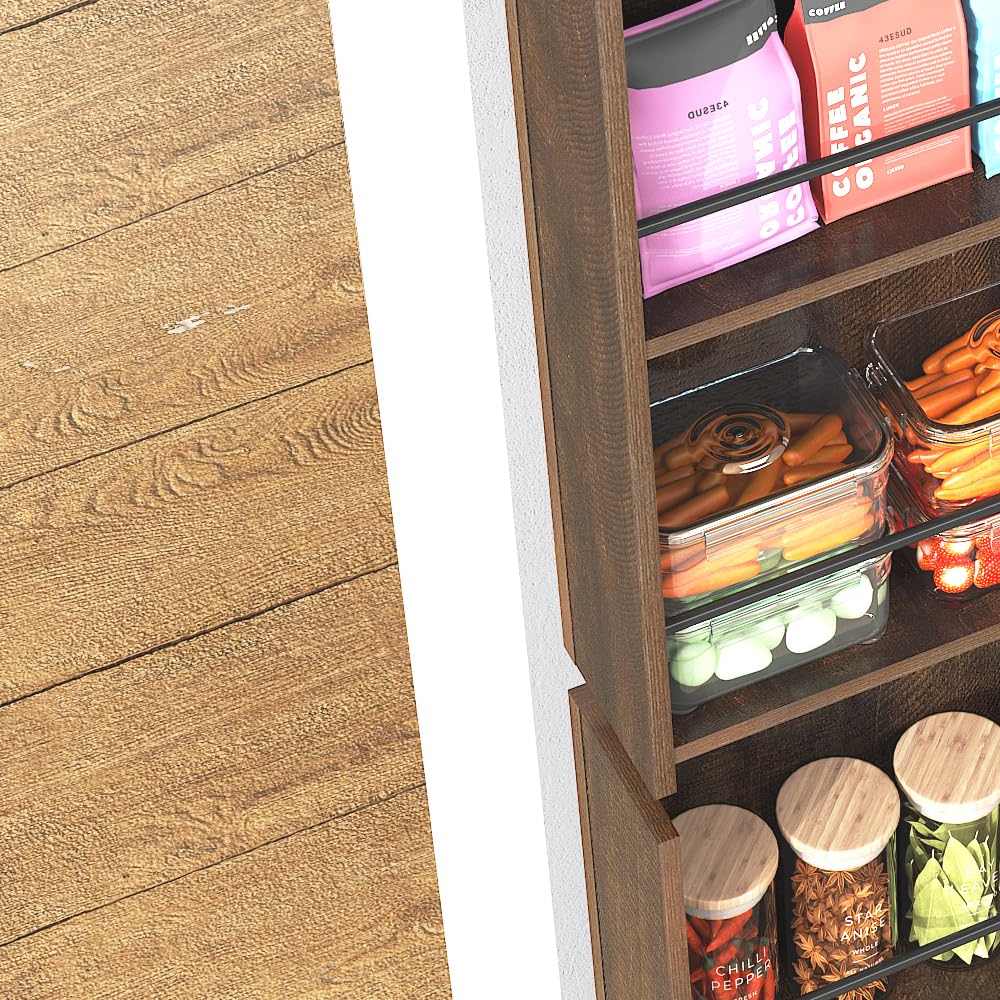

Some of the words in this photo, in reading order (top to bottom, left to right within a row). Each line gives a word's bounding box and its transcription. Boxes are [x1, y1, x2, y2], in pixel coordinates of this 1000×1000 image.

[809, 1, 846, 17] COFFEE
[879, 27, 912, 43] 43ESUD
[849, 52, 874, 190] OGANIC
[844, 902, 882, 927] STAR
[840, 915, 886, 942] ANISE
[715, 946, 766, 976] CHILLI
[852, 941, 879, 955] WHOLE
[711, 959, 771, 991] PEPPER
